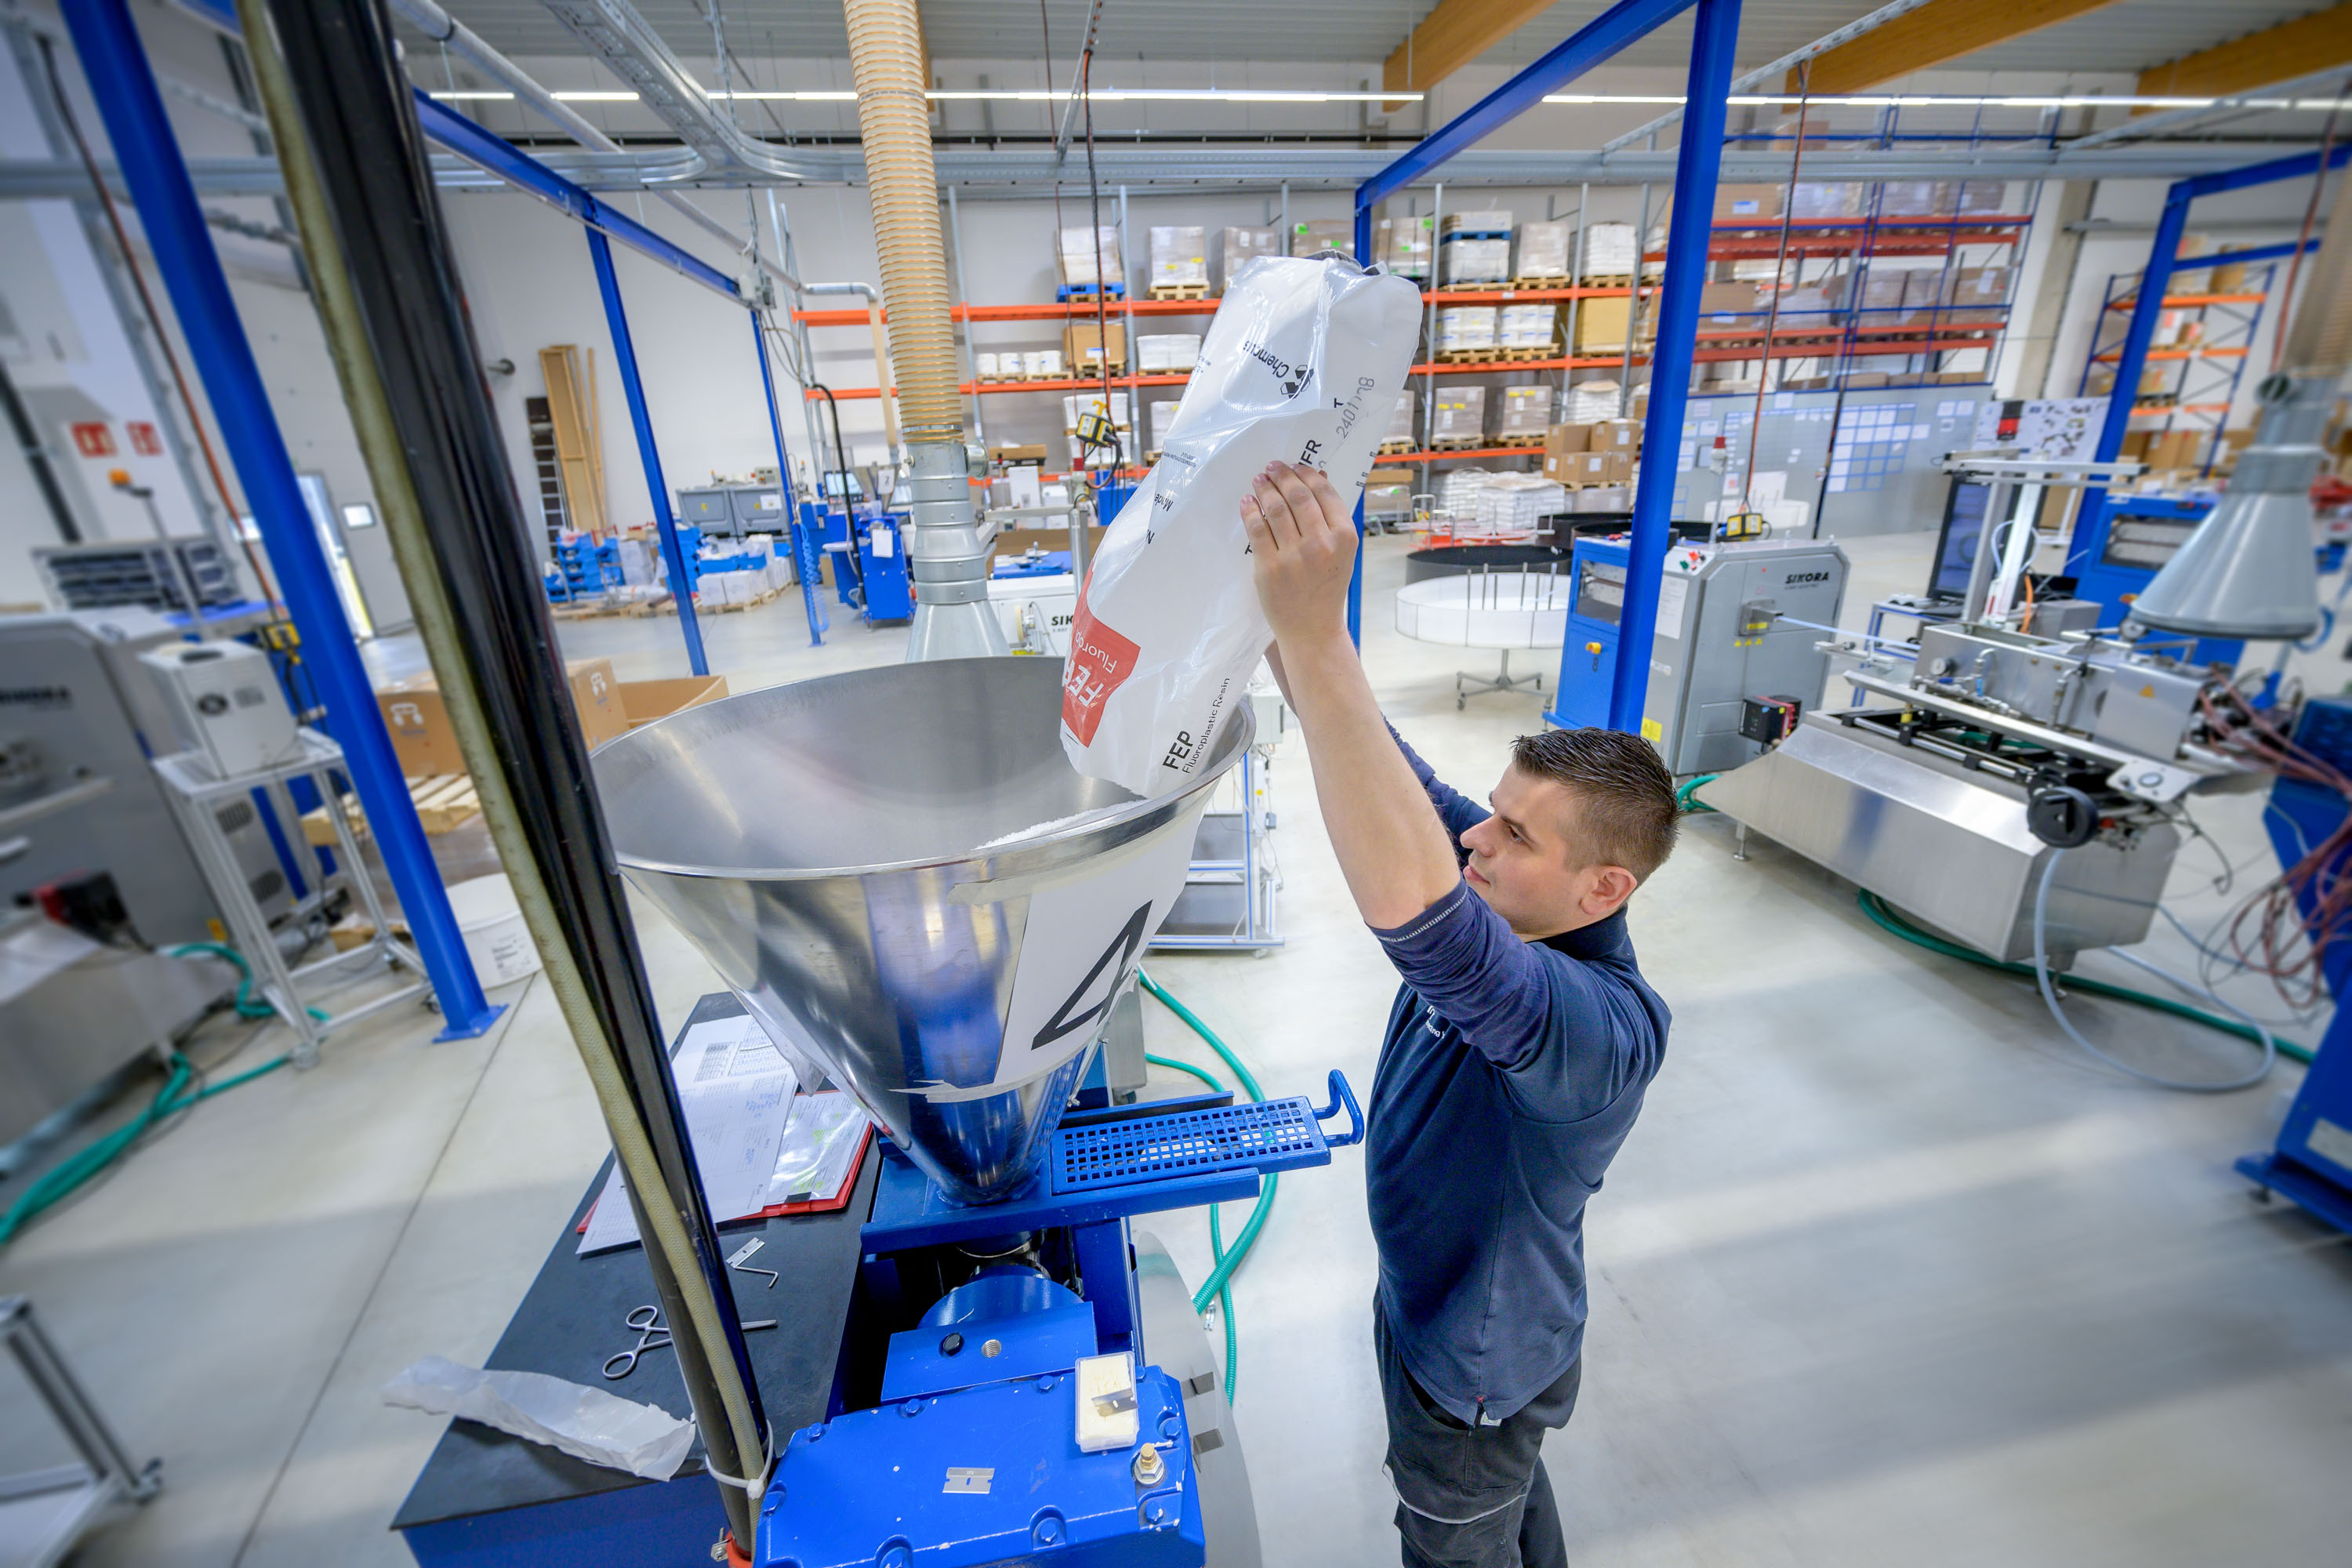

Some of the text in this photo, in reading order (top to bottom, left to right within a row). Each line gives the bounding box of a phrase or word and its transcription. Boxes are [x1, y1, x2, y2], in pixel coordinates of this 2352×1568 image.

[1299, 439, 1322, 466] FR
[1785, 572, 1829, 584] SIKORA
[1592, 657, 1599, 672] 8
[1182, 677, 1230, 773] Fluoroplastic Resin
[1163, 731, 1192, 769] FEP
[1031, 899, 1152, 1051] 4
